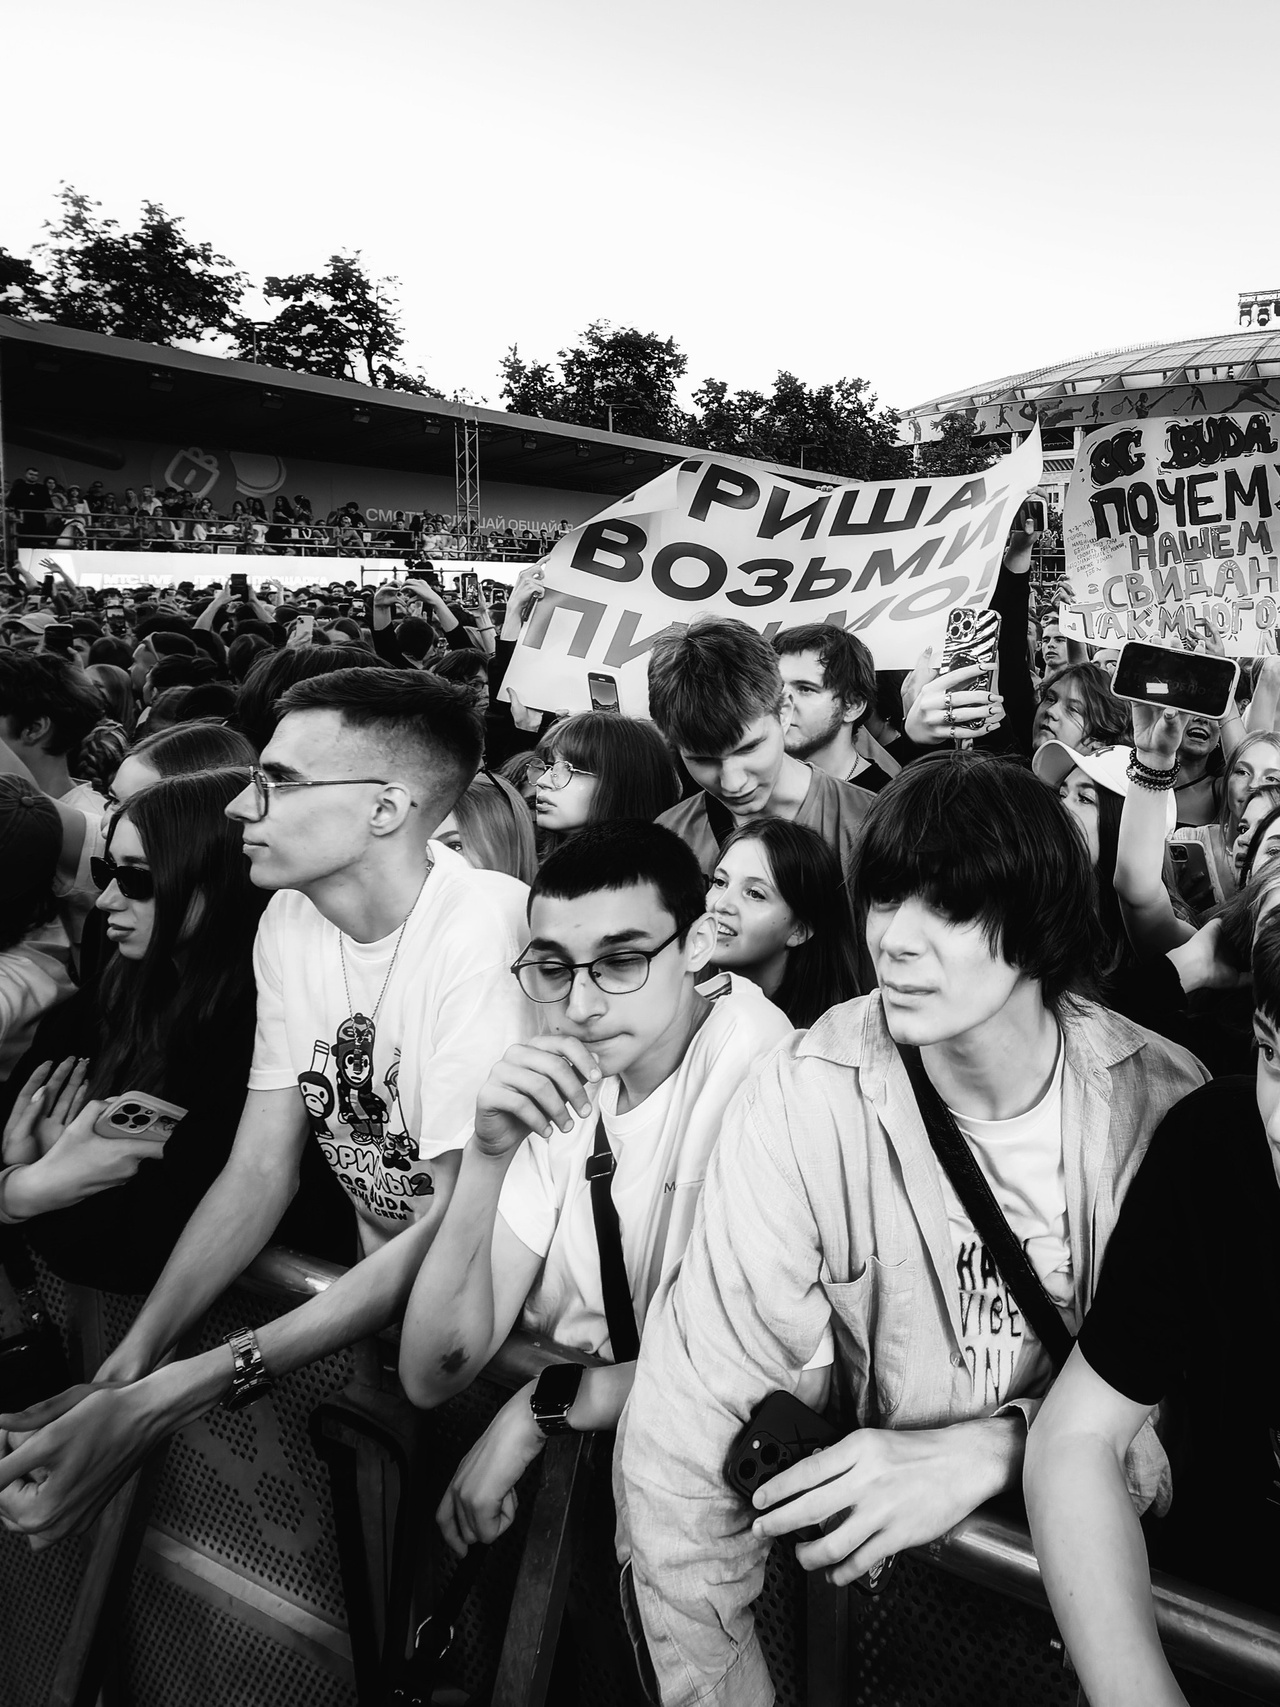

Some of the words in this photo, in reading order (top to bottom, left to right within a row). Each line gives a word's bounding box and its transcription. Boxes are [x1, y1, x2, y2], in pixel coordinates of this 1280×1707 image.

[366, 508, 426, 524] СМОТ
[679, 459, 1010, 540] РИША,
[570, 495, 1009, 608] ВОЗЬМИ
[1129, 520, 1275, 572] НАШЕМ
